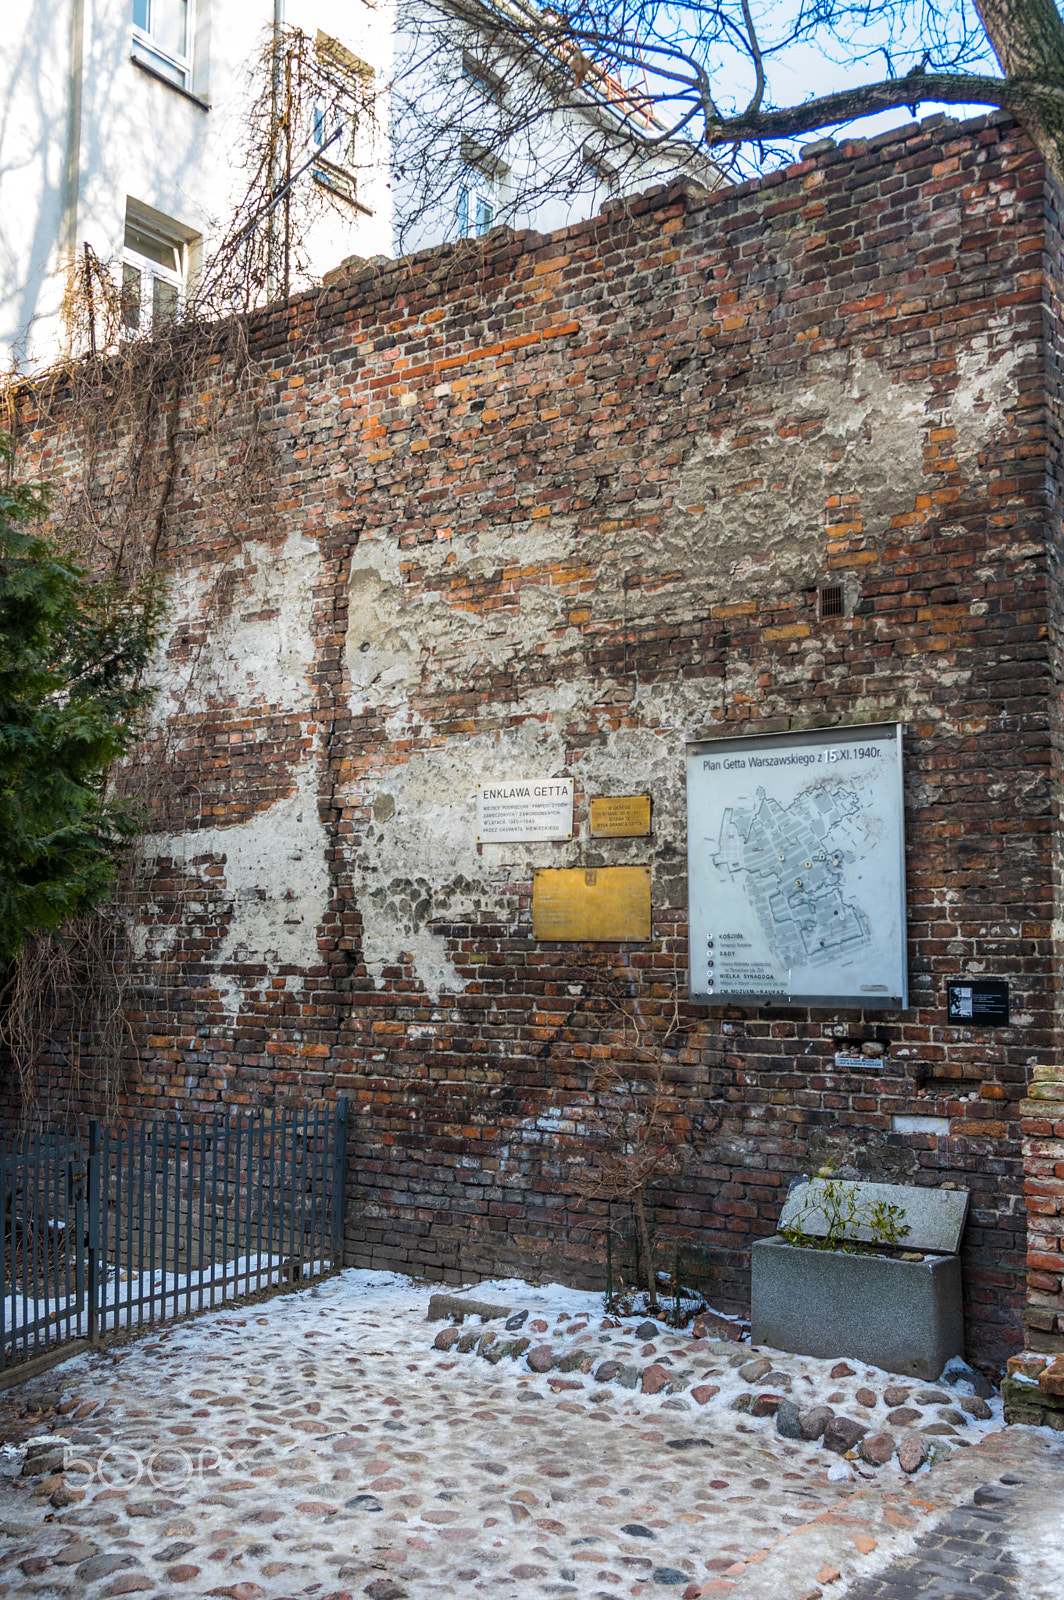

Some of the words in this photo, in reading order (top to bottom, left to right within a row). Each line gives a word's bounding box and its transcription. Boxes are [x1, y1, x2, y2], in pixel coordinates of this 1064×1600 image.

[703, 760, 721, 771] Plan
[723, 757, 746, 770] Getta
[749, 753, 816, 767] Warszawskiego
[817, 754, 822, 762] z
[483, 787, 530, 799] ENKLAWA
[534, 785, 568, 797] GETTA
